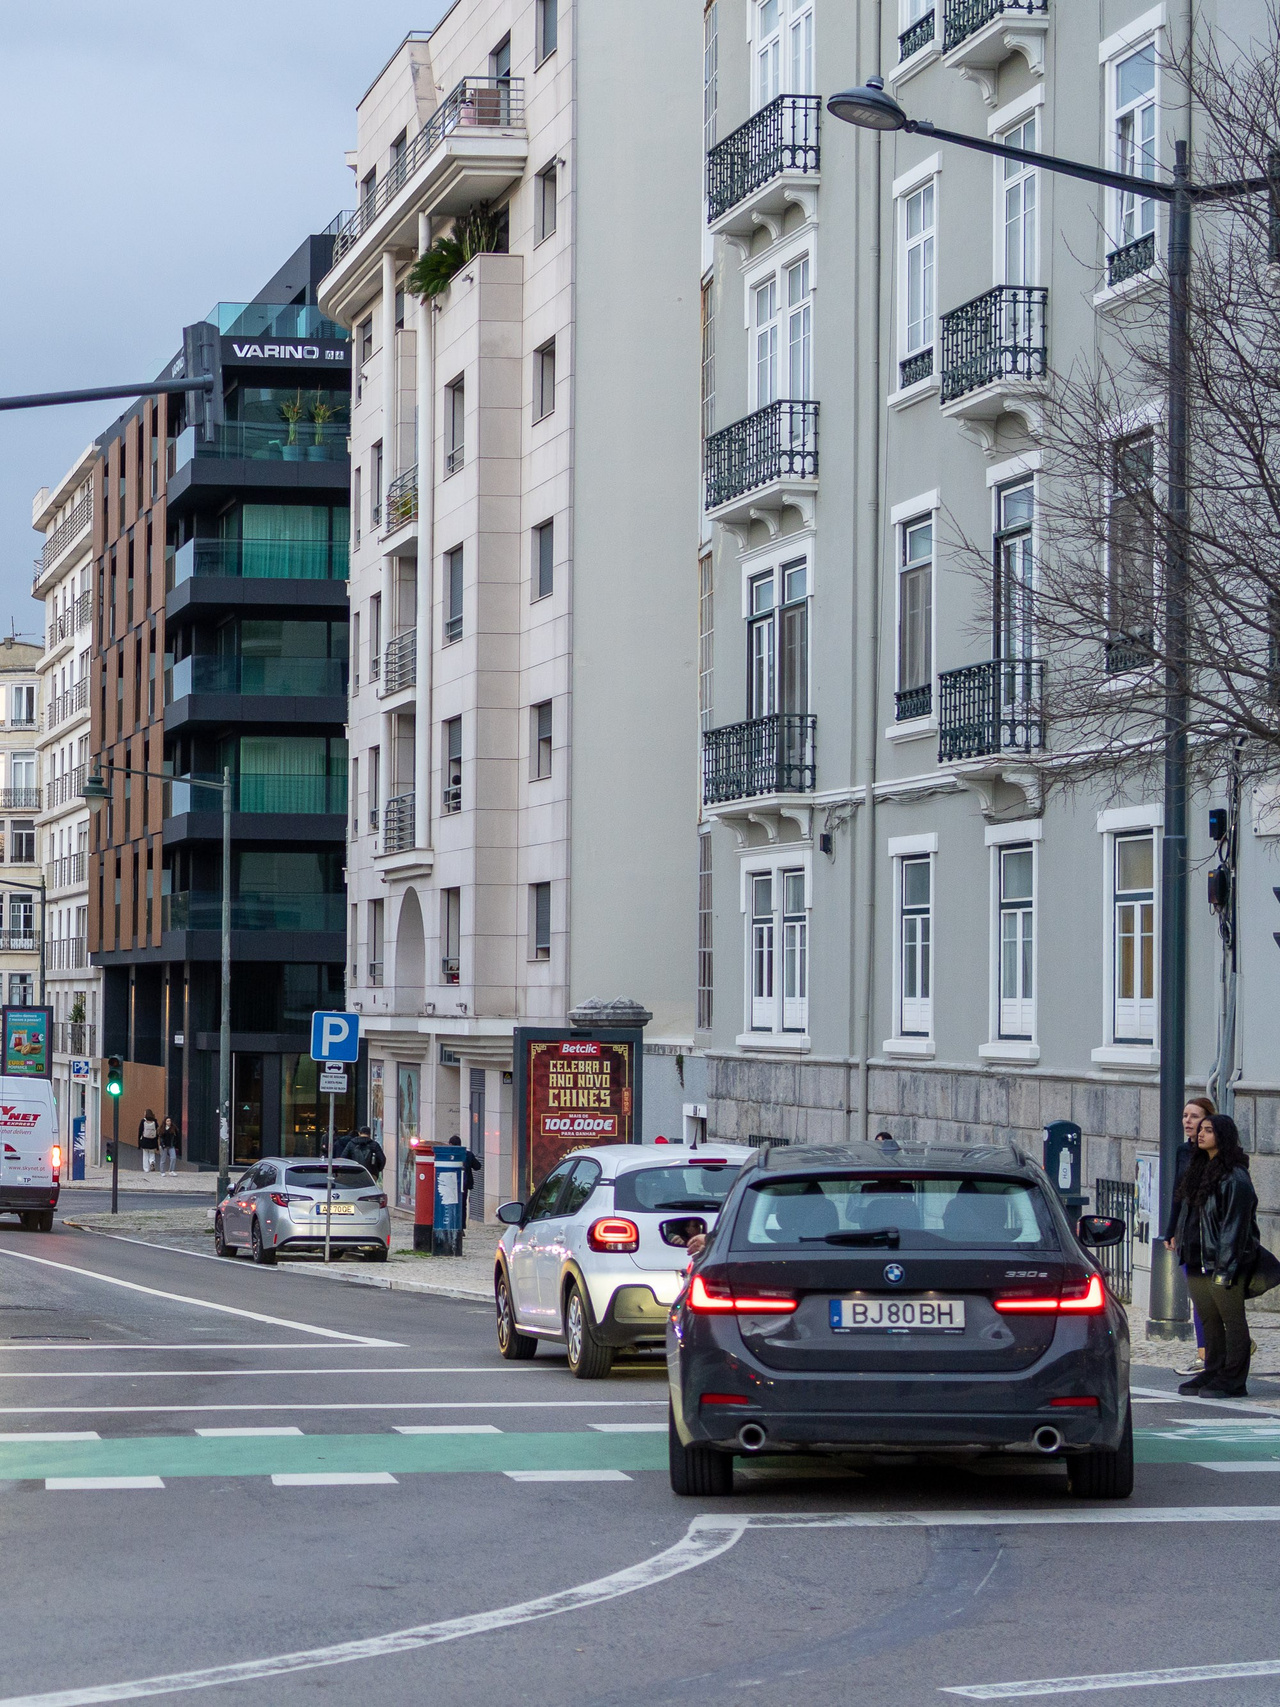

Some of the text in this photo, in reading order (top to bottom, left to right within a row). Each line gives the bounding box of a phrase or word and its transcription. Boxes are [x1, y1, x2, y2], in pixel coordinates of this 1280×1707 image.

[232, 344, 319, 359] VARINO
[31, 1032, 44, 1043] 2€
[322, 1016, 349, 1056] P
[562, 1043, 598, 1054] Betclic
[74, 1062, 80, 1072] P
[549, 1060, 611, 1074] CELEBRA O
[549, 1074, 610, 1088] ANO NOVO
[548, 1087, 611, 1107] CHINÊS
[8, 1113, 41, 1121] NET
[545, 1118, 614, 1131] 100.000€
[852, 1303, 954, 1325] BJ80BH
